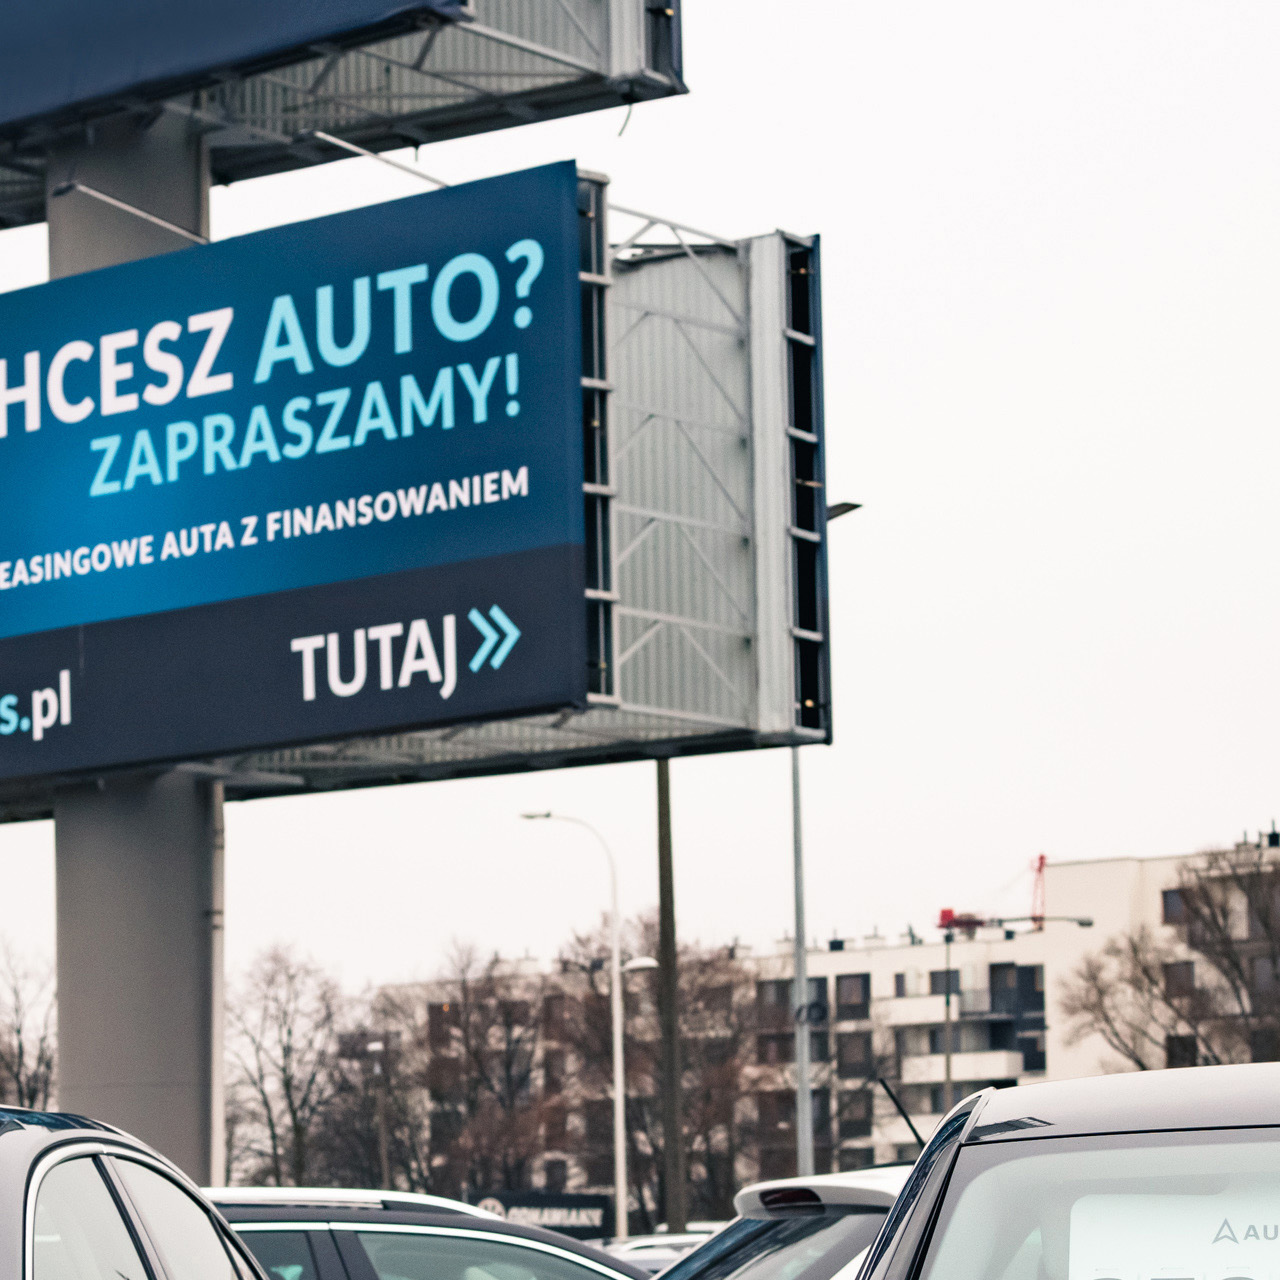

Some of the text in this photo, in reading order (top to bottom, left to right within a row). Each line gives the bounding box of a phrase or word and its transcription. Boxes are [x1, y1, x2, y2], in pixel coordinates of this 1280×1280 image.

[254, 238, 545, 384] AUTO?
[89, 352, 521, 497] ZAPRASZAMY!
[161, 520, 234, 562] AUTA
[240, 516, 259, 548] Z
[266, 466, 529, 542] FINANSOWANIEM
[290, 613, 459, 703] TUTAJ
